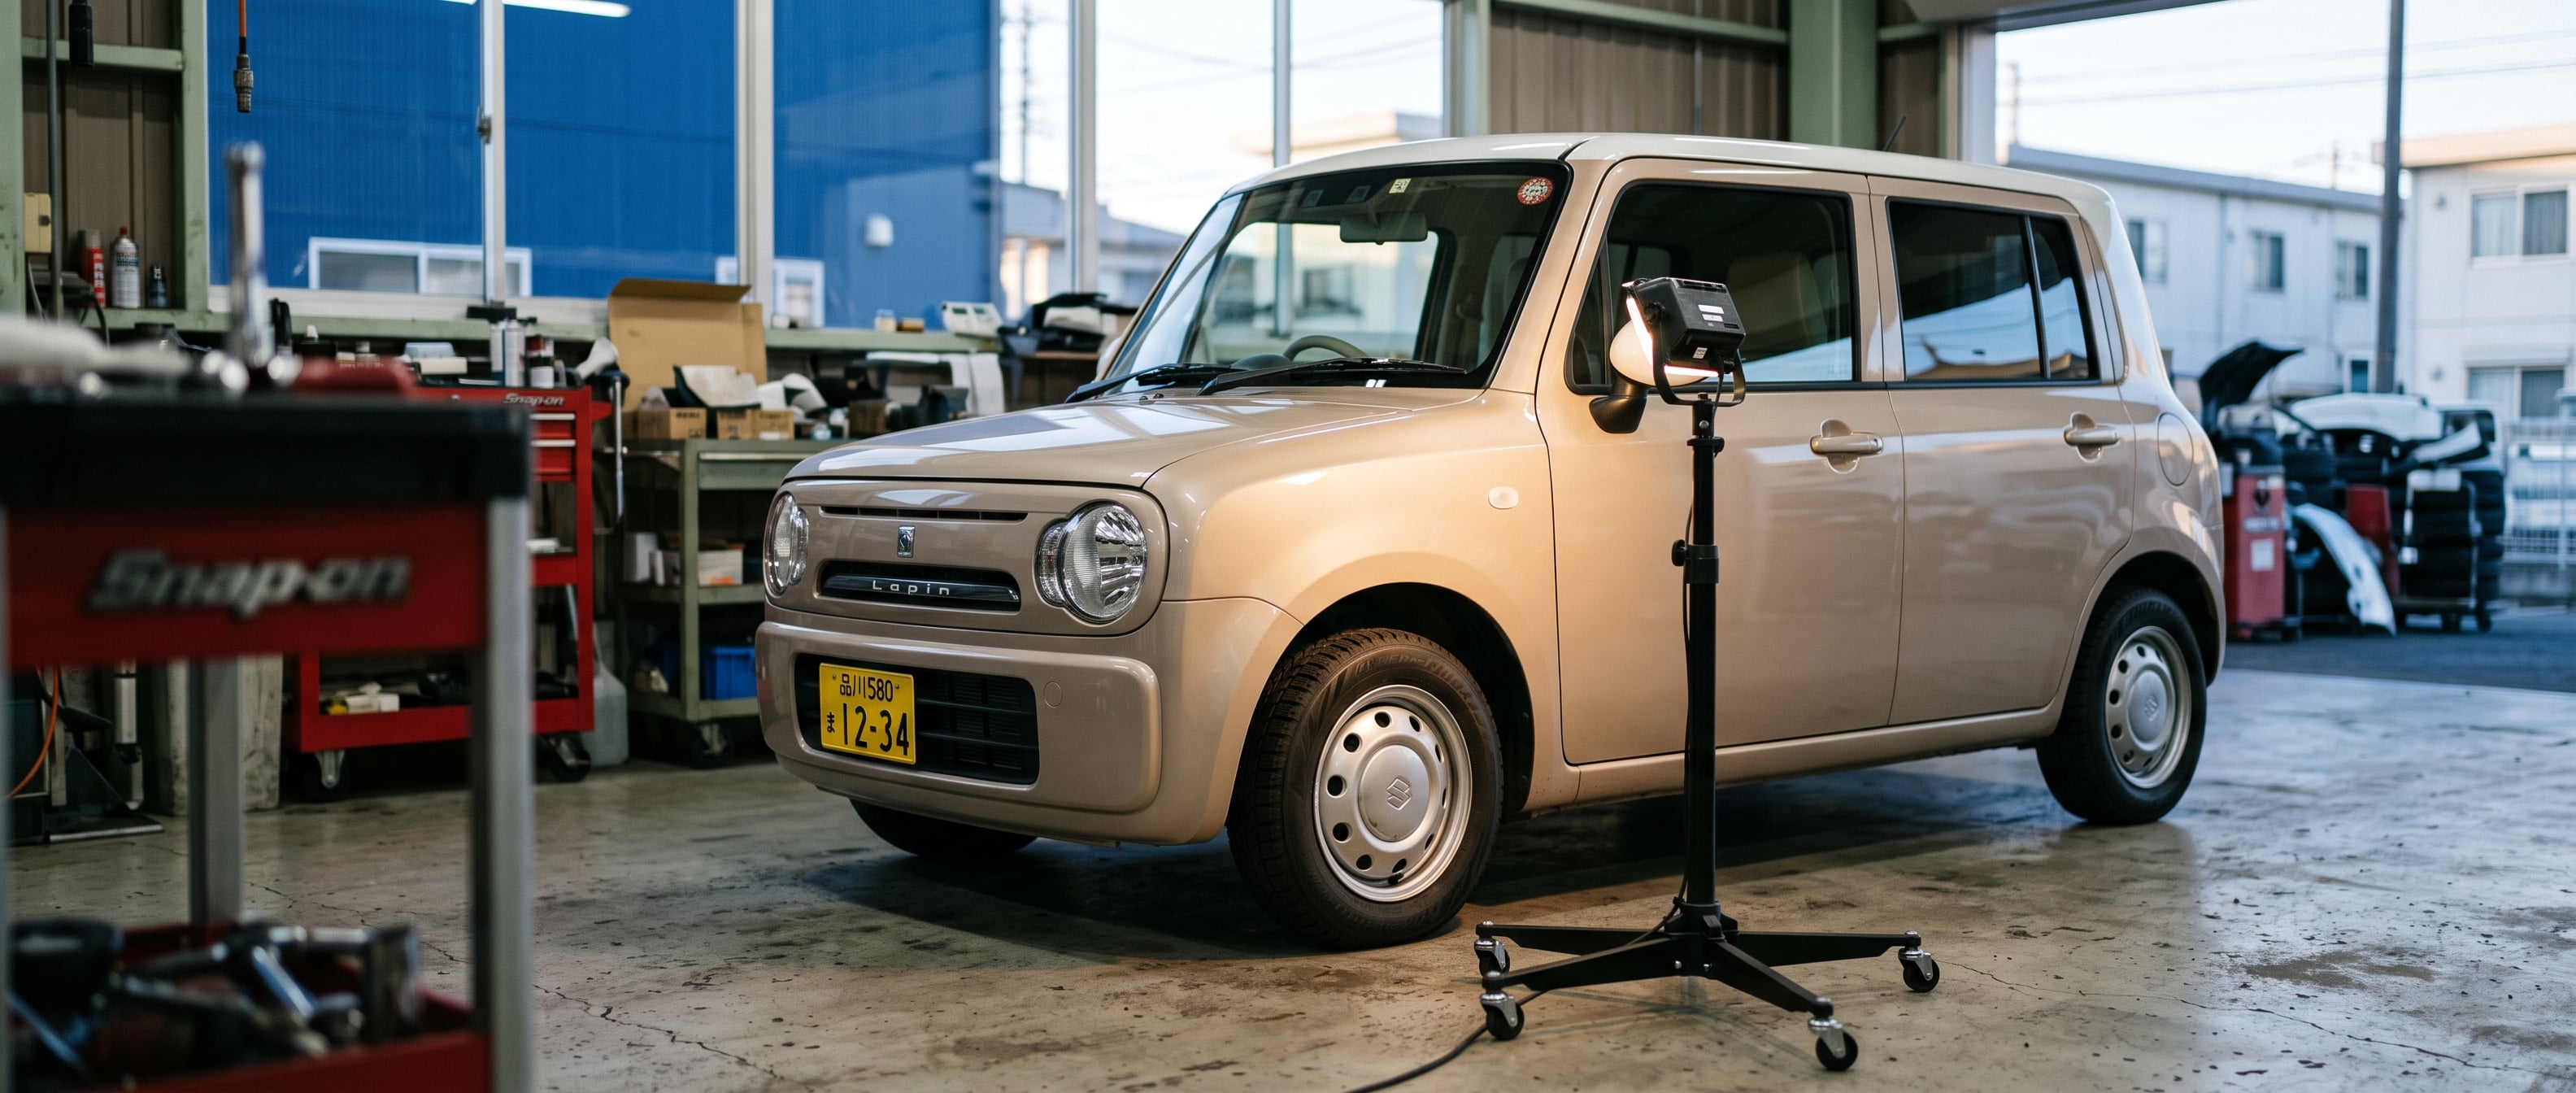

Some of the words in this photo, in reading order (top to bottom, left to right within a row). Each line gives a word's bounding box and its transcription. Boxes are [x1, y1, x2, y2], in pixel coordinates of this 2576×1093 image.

[503, 393, 564, 406] Snap-on
[87, 550, 411, 620] Snap-on
[872, 580, 950, 595] Lapin
[826, 712, 835, 733] ま
[842, 703, 910, 756] 12-34
